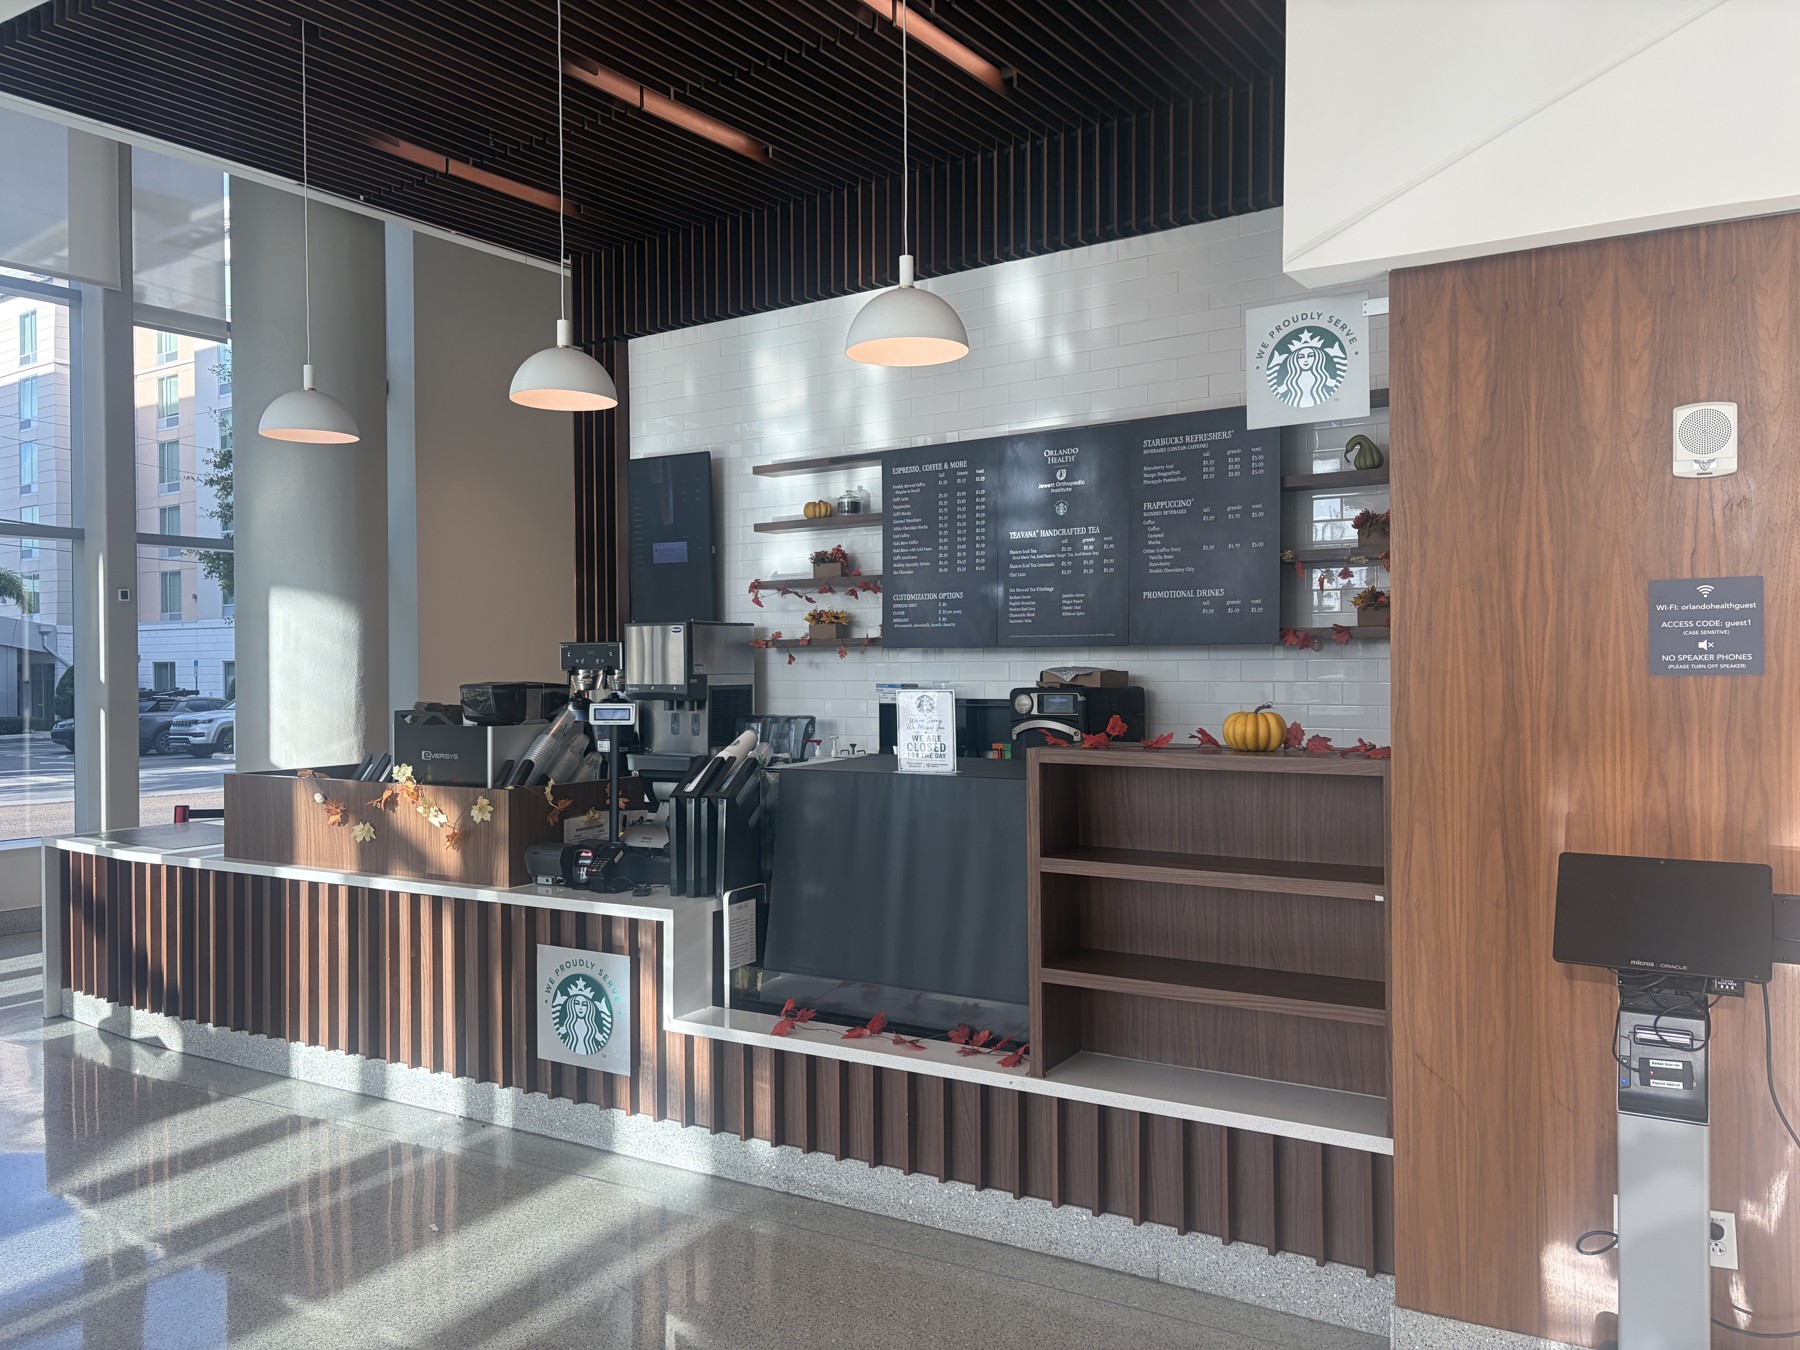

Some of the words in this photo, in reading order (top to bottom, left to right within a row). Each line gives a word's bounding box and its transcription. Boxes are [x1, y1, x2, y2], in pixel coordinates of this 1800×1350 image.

[1256, 341, 1269, 359] WE
[1268, 312, 1323, 339] PROUDLY
[1327, 315, 1357, 345] SERVE
[1143, 435, 1184, 447] STARBUCKS
[1044, 447, 1079, 457] ORLANDO
[892, 466, 921, 475] ESPRESSO,
[922, 463, 943, 471] COFFEE
[950, 460, 967, 468] MORE
[1056, 479, 1085, 488] Orthopedic
[1040, 527, 1086, 537] HANDCRAFTED
[1088, 526, 1100, 534] TEA
[893, 593, 937, 601] CUSTOMIZATION
[1143, 590, 1194, 599] PROMOTIONAL
[1196, 589, 1225, 597] DRINKS
[1681, 602, 1756, 611] orlandohealthguest
[1661, 620, 1694, 628] ACCESS
[1725, 620, 1751, 628] guest1
[907, 742, 946, 752] CLOSED
[1630, 959, 1655, 967] micros
[1660, 963, 1688, 971] ORACLE
[545, 977, 555, 994] WE
[554, 959, 595, 976] PROUDLY
